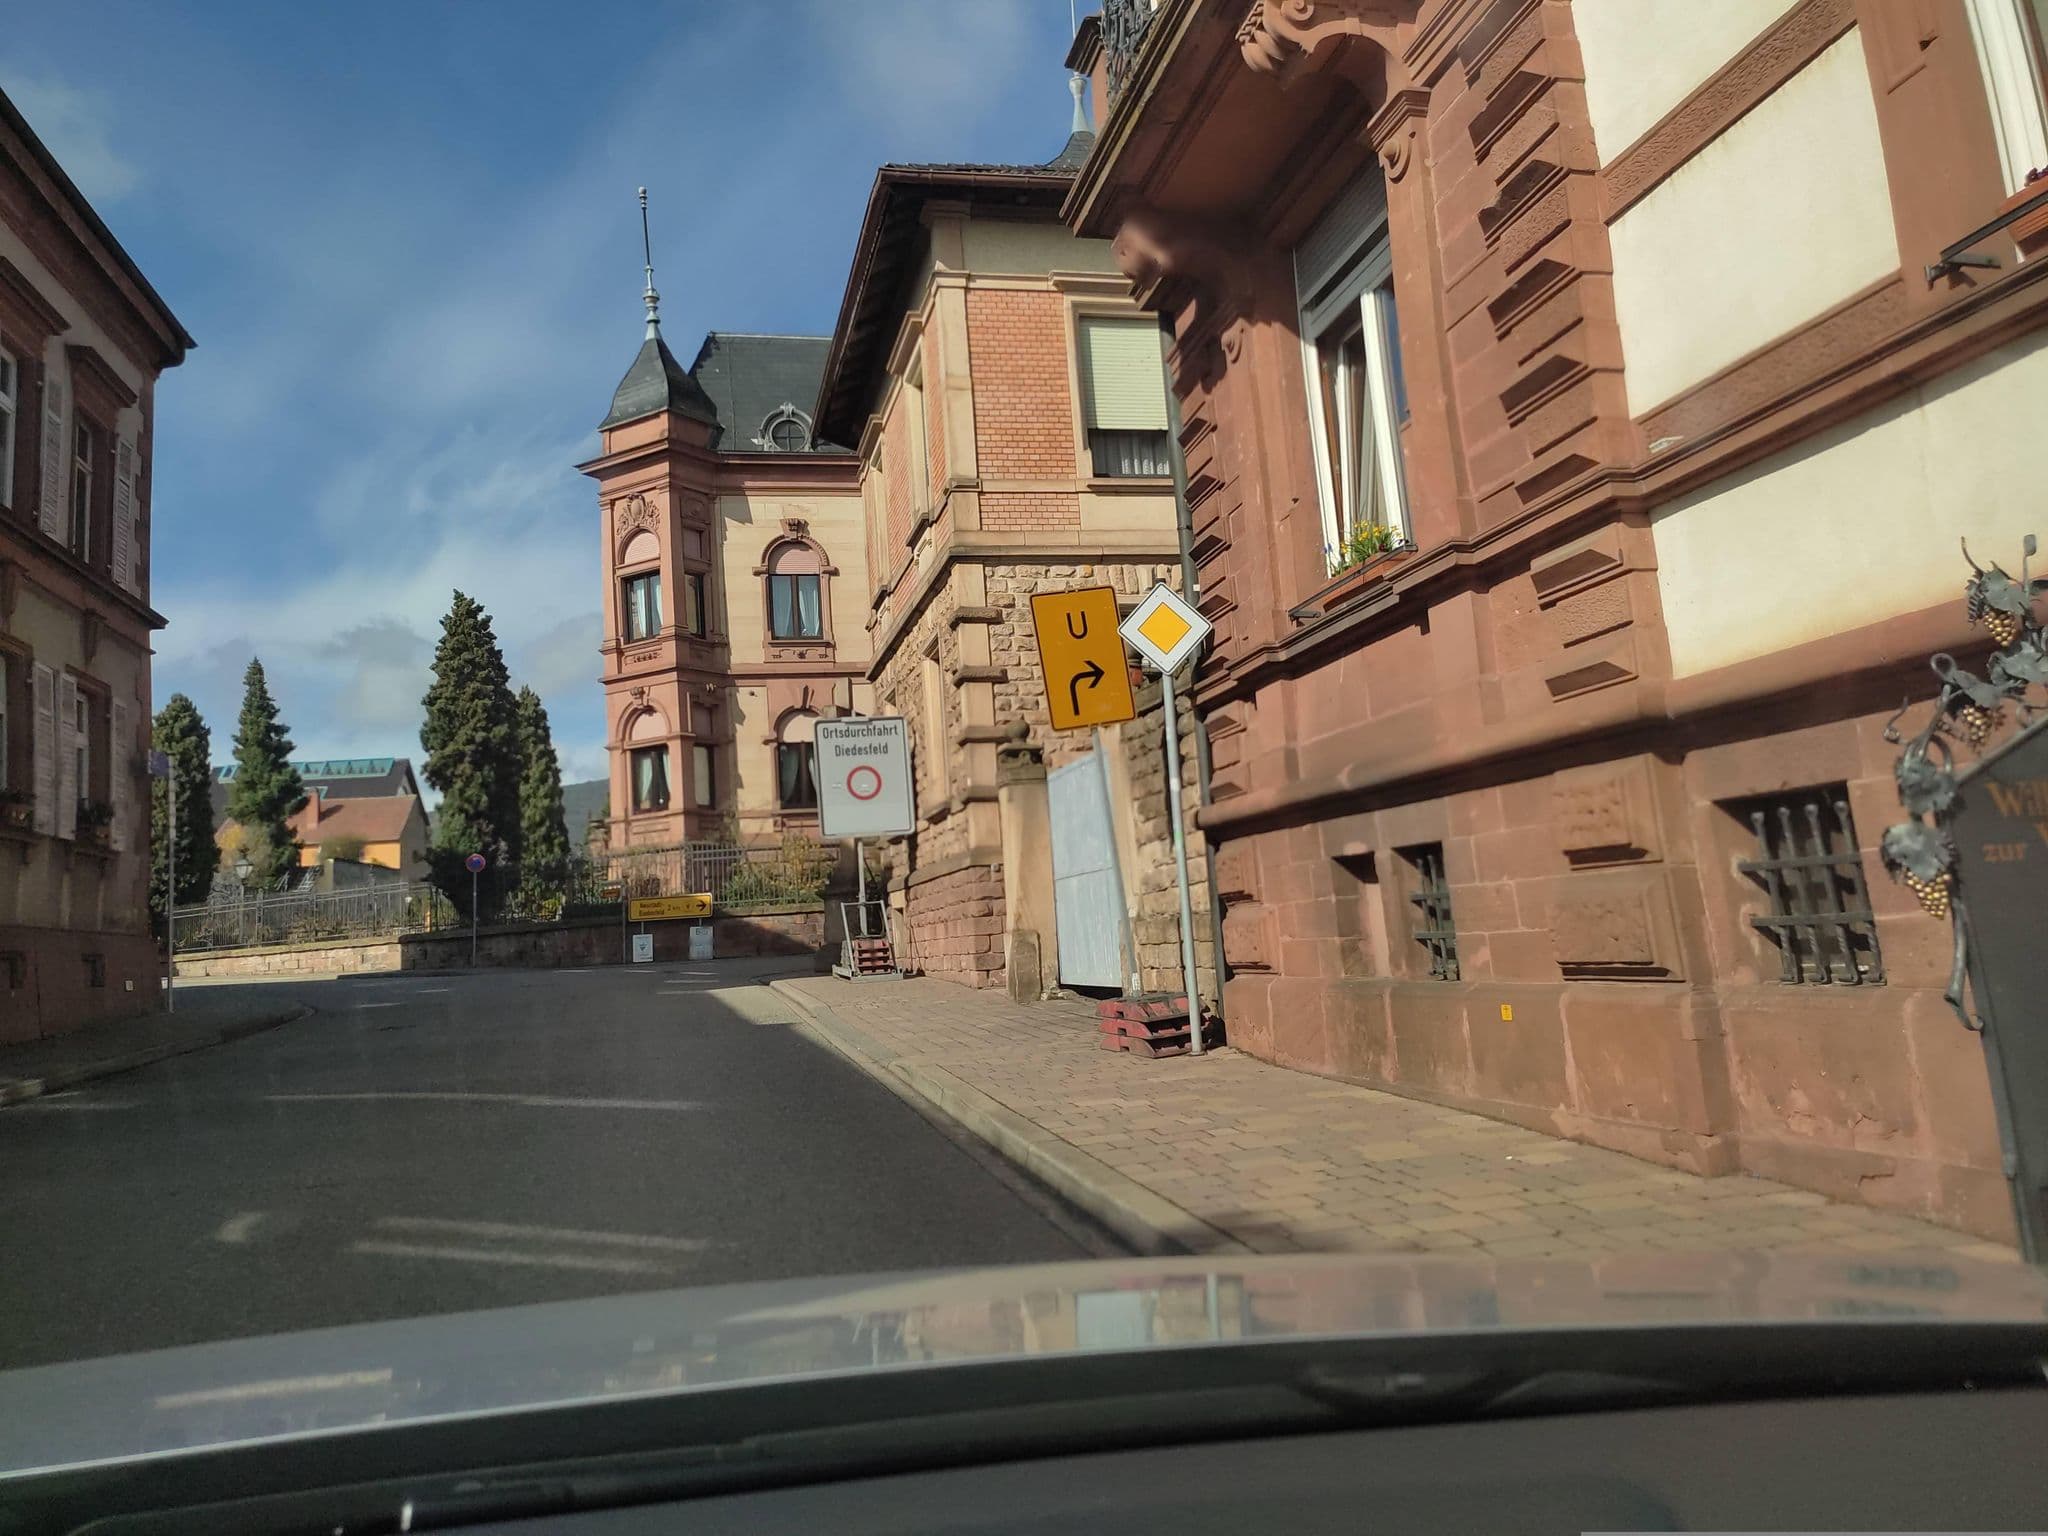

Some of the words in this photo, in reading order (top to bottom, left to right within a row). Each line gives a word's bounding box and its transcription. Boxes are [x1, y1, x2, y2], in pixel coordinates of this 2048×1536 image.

[1066, 610, 1088, 640] U
[822, 724, 898, 739] Ortsdurchfahrt
[834, 742, 889, 757] Diedesfeld
